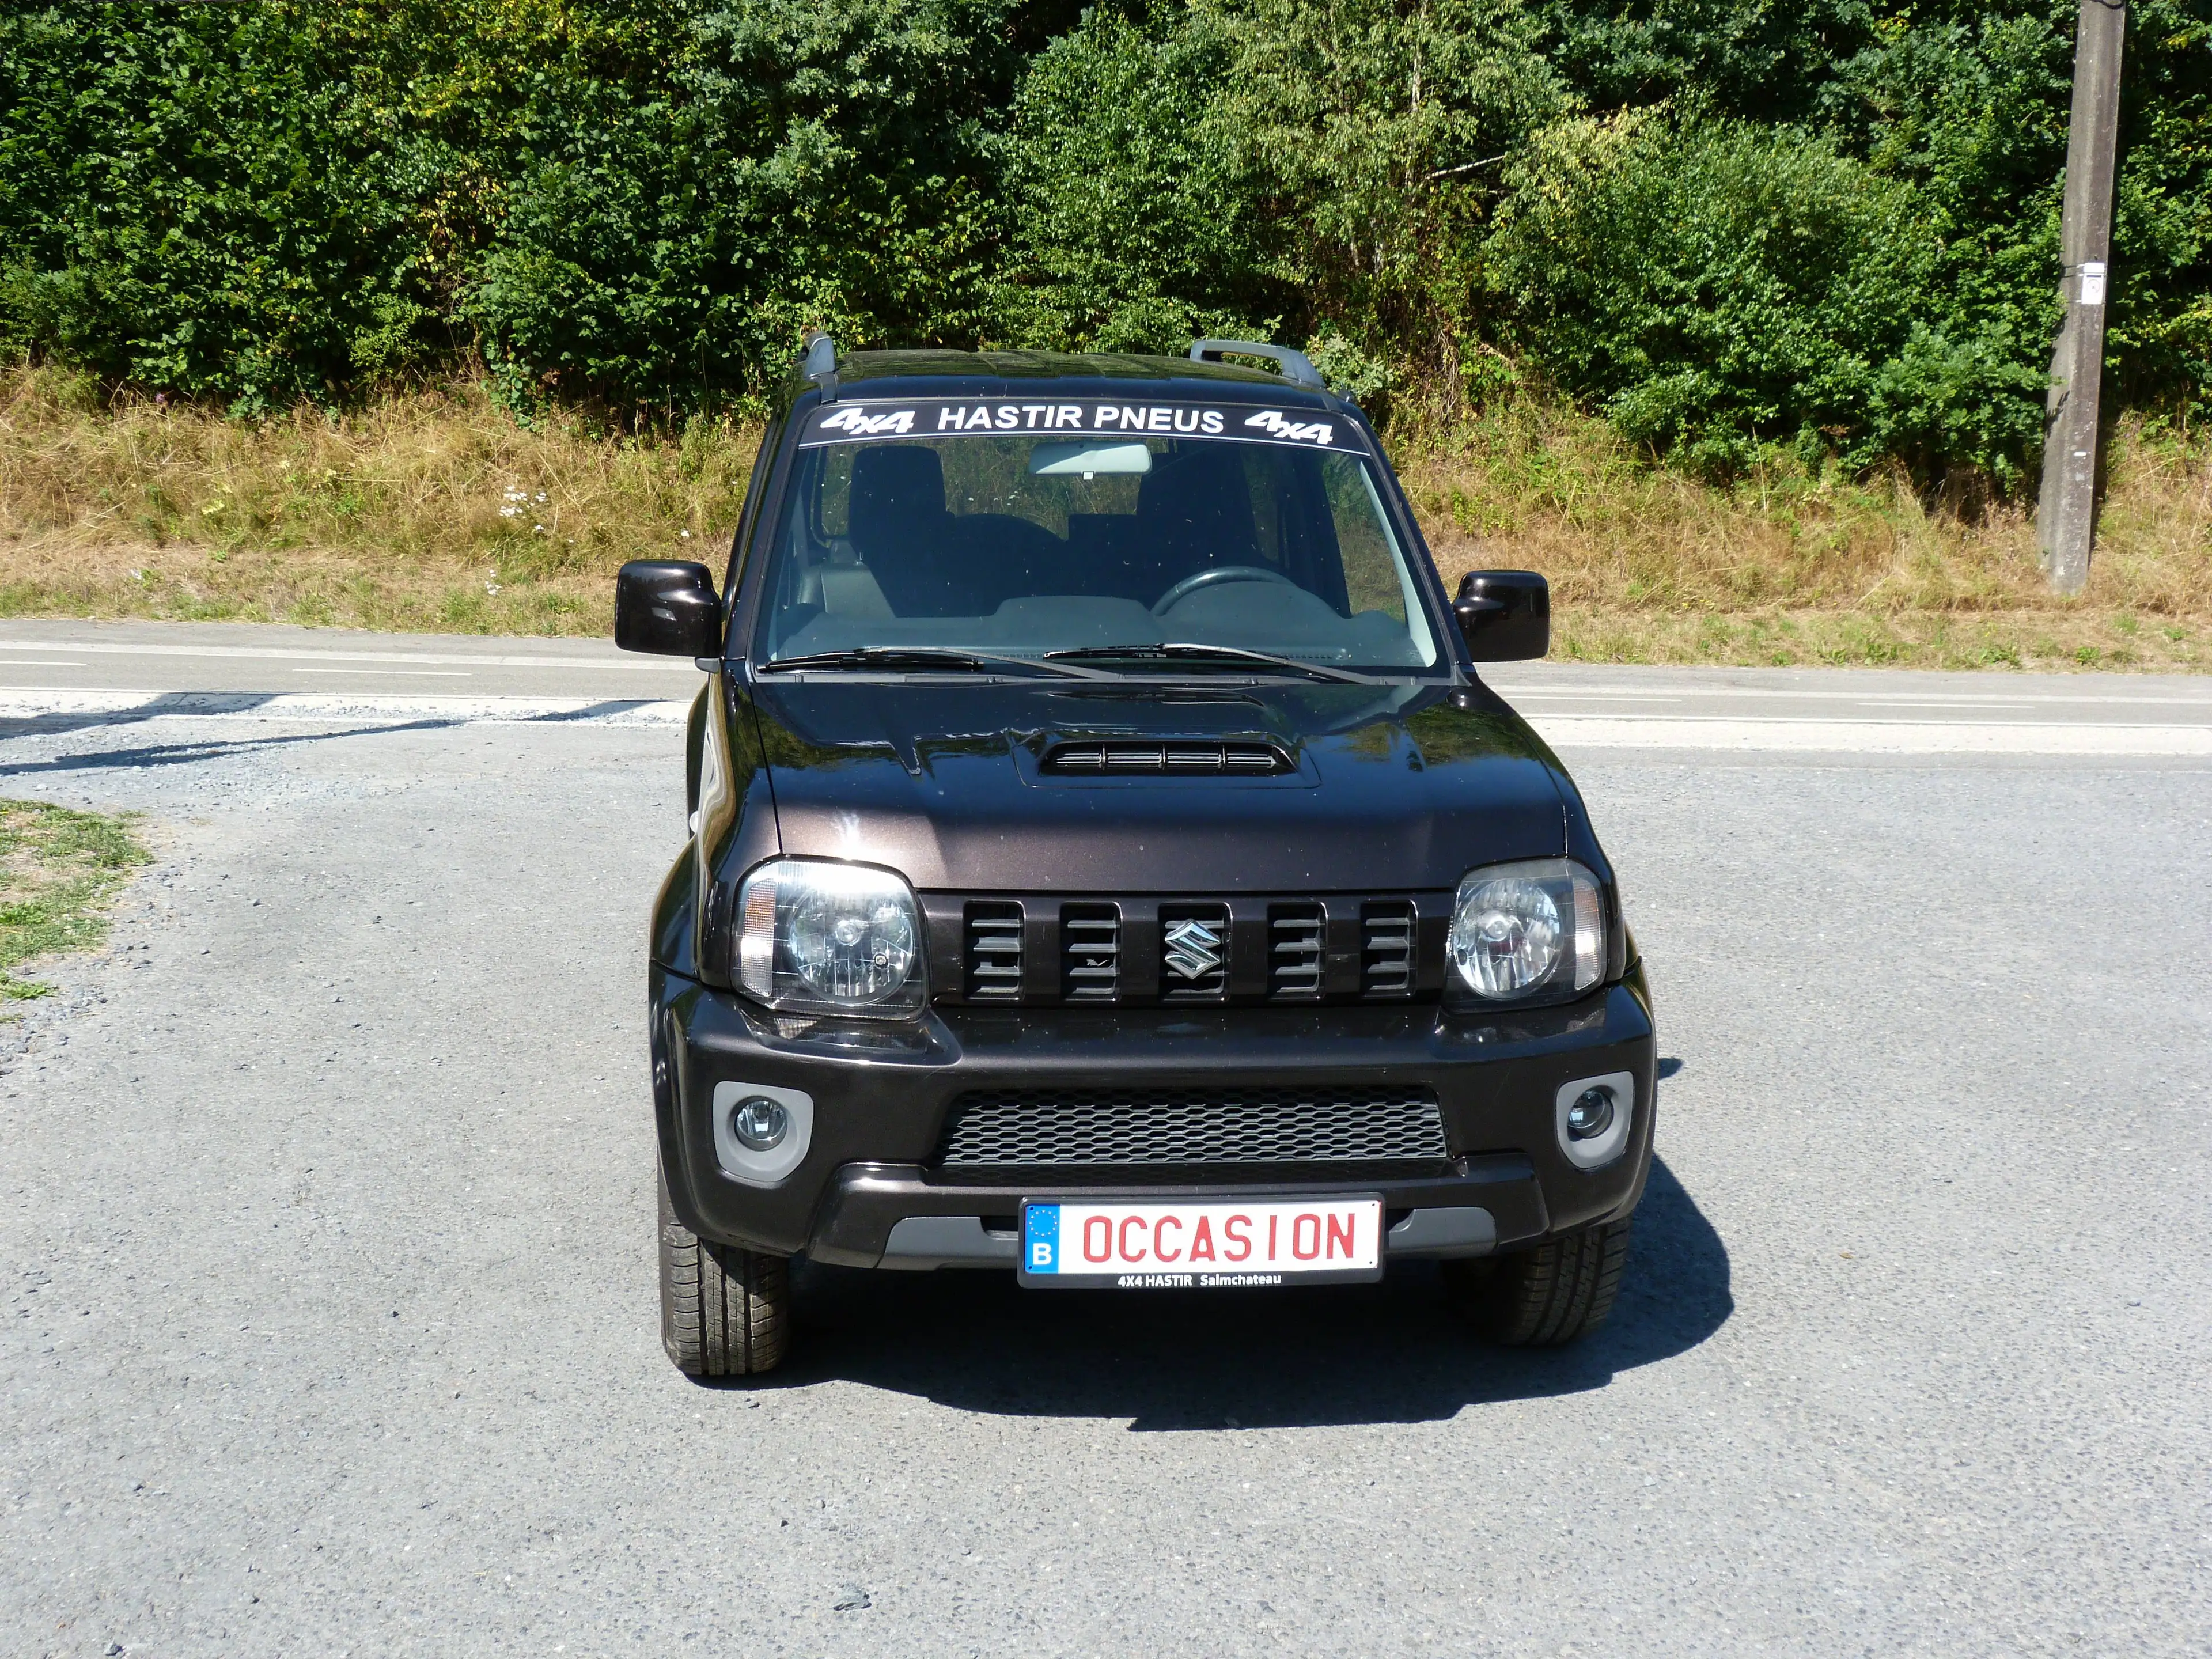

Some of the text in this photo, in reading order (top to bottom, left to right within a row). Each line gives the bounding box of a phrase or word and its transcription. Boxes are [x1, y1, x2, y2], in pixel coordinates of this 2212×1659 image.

[820, 406, 1334, 444] 4x4 HASTIR PNEUS 4x4
[1083, 1213, 1355, 1263] OCCASION
[1032, 1243, 1052, 1266] B
[1118, 1274, 1282, 1287] 4X4 HASTIR Salmchateau
